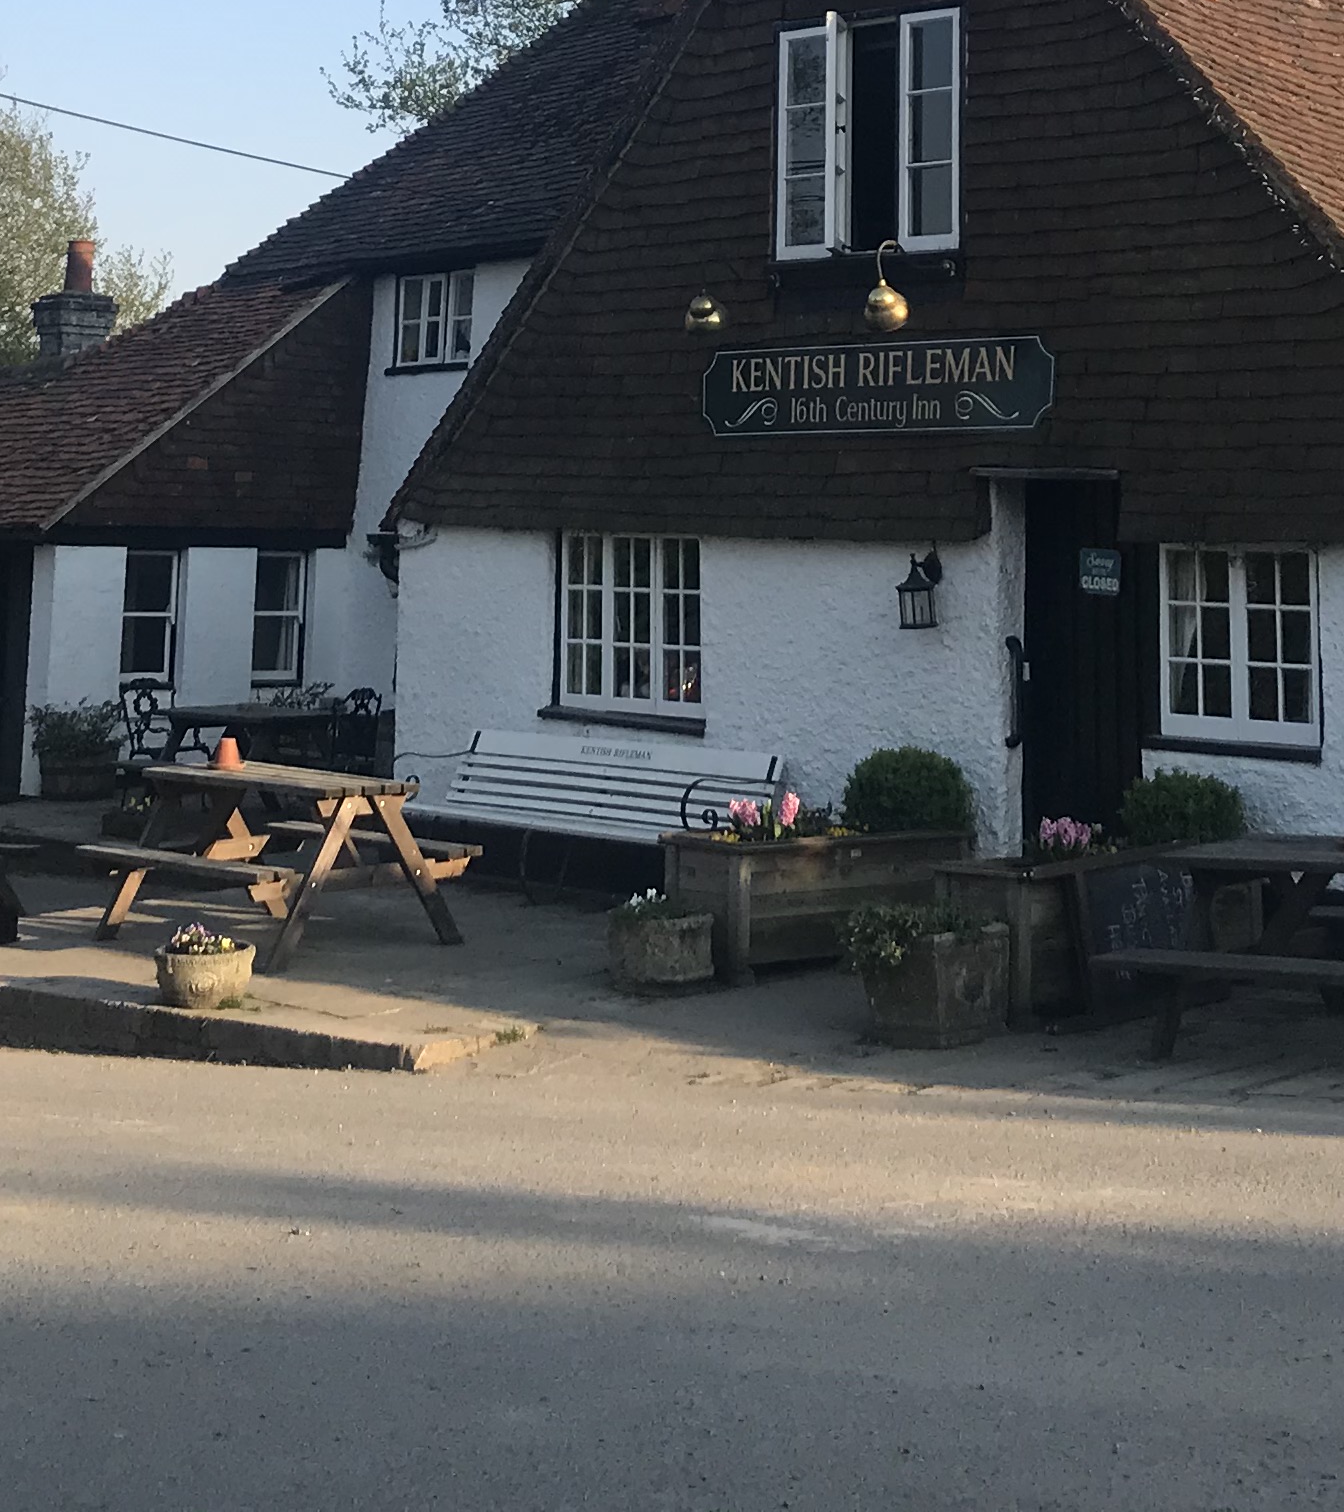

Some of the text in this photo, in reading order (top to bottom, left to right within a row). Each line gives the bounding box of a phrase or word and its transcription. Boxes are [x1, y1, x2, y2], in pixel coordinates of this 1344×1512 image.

[731, 345, 1017, 393] KENTISH RIFLEMAN
[790, 393, 941, 428] 16th Century Inn
[1081, 575, 1119, 591] CLOSED
[581, 745, 653, 760] KENTISH RIFLEMAN
